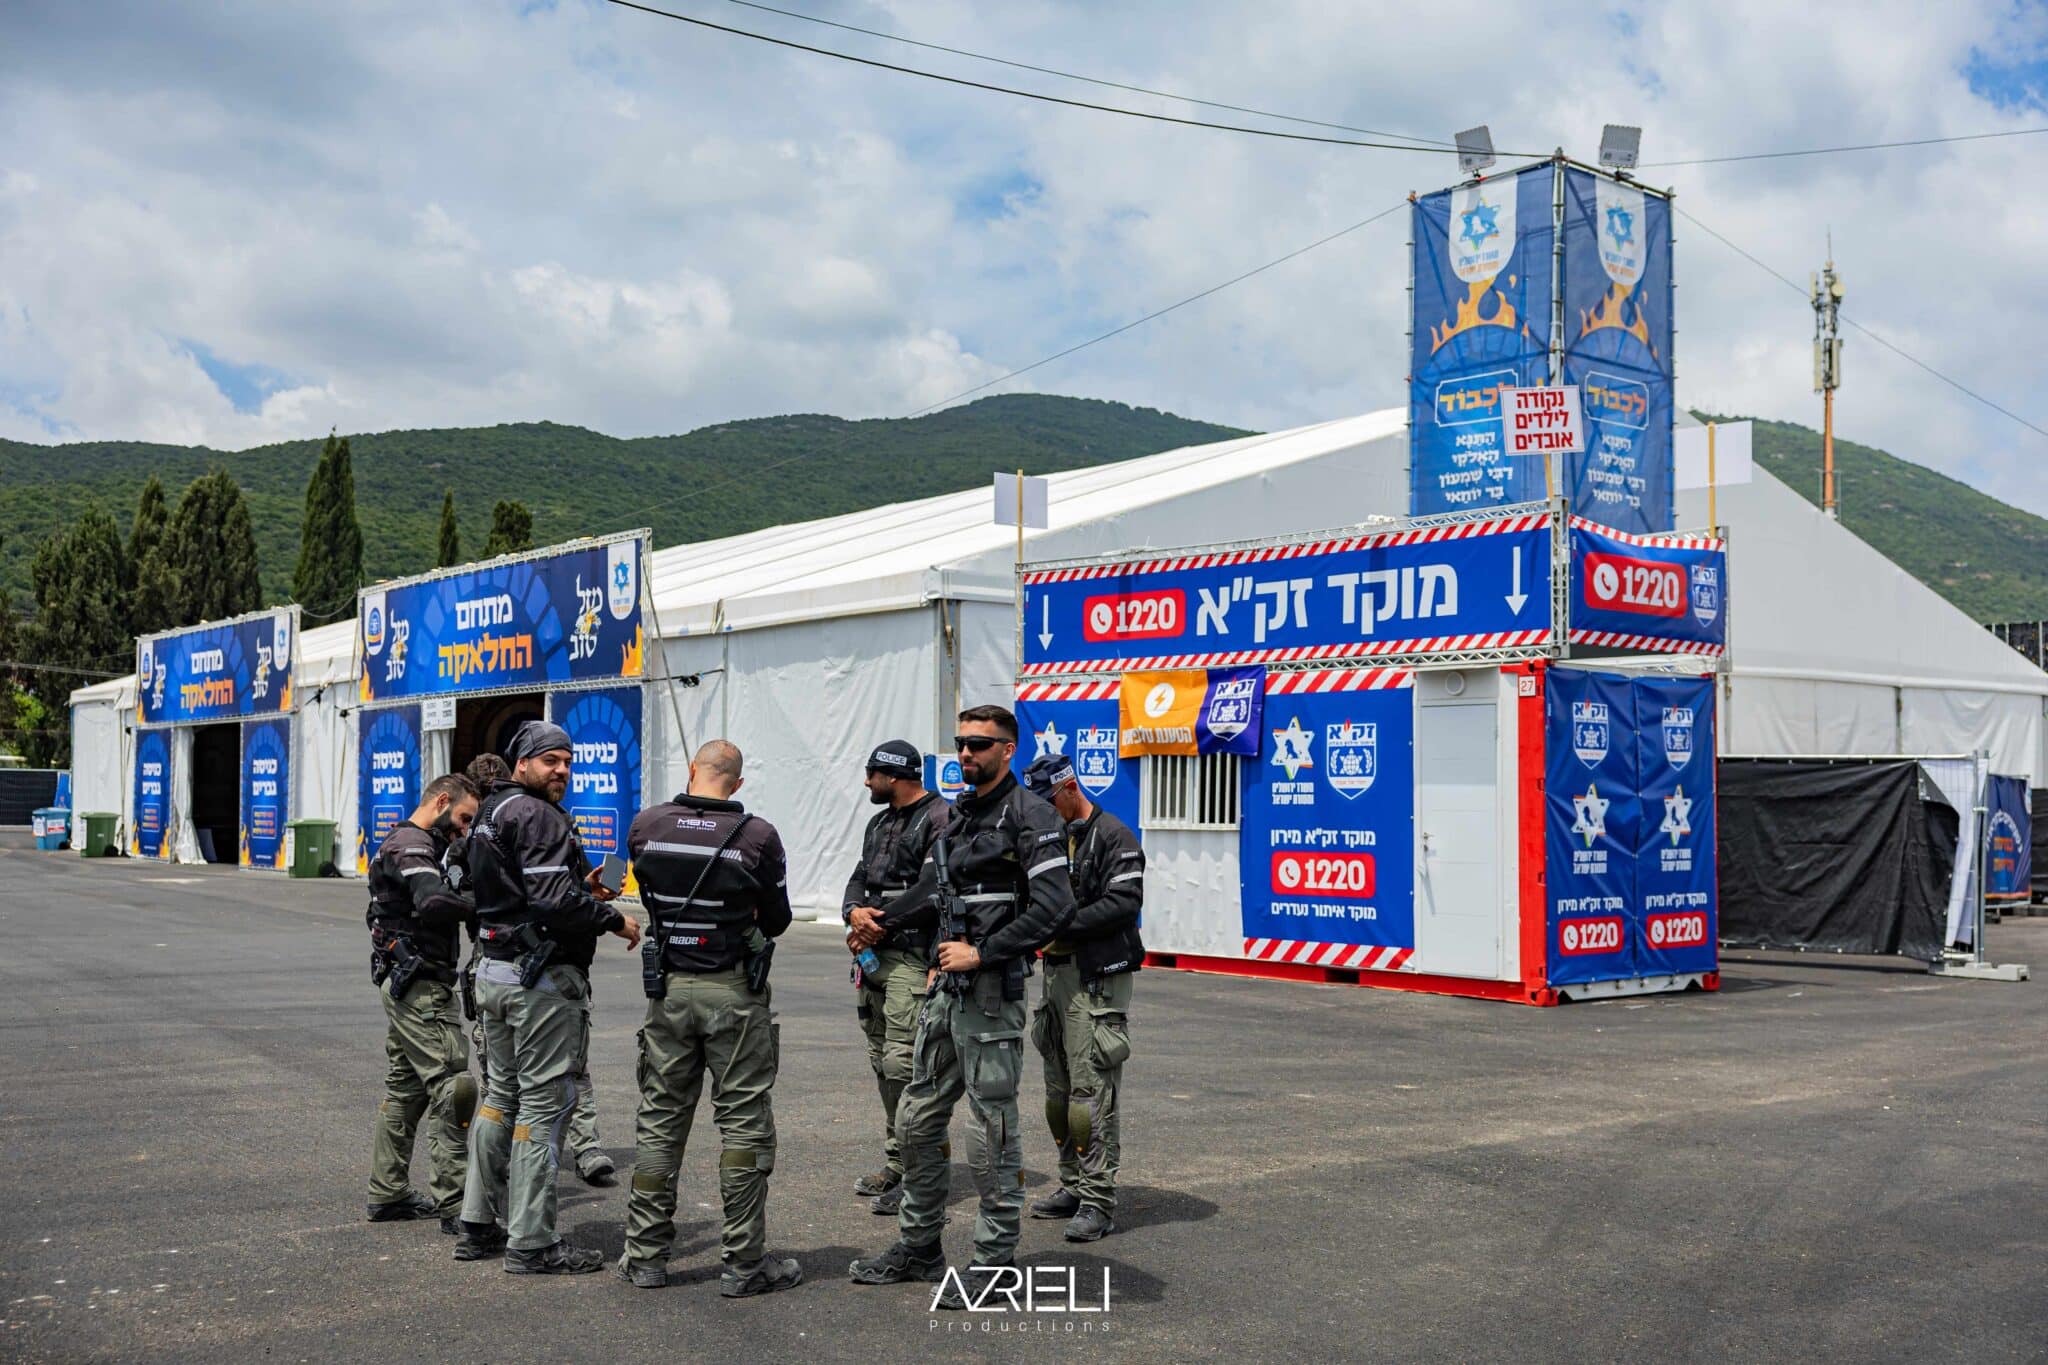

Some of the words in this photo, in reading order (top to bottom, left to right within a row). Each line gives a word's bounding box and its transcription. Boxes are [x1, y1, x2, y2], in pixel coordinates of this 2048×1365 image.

[1516, 391, 1564, 411] נקודה
[1515, 409, 1569, 429] לילדים
[1515, 432, 1573, 450] אובדים
[1621, 565, 1680, 609] 1220
[1327, 564, 1458, 635] מוקד
[455, 593, 513, 630] מתחם
[1116, 597, 1176, 633] 1220
[1196, 576, 1313, 644] זק"א
[191, 649, 224, 675] מתחם
[438, 632, 533, 684] החלאקה
[180, 676, 234, 714] החלאקה
[1520, 680, 1534, 693] 27
[372, 751, 405, 770] כניסה
[572, 742, 617, 764] כניסה
[876, 752, 906, 765] POLICE
[372, 776, 405, 795] גברים
[572, 772, 618, 794] גברים
[1270, 829, 1302, 847] מירון
[1305, 828, 1339, 848] זק"א
[1341, 830, 1376, 848] מוקד
[1304, 859, 1366, 891] 1220
[1271, 902, 1309, 915] נעדרים
[1557, 899, 1578, 914] מירון
[1603, 897, 1624, 912] מוקד
[1645, 895, 1665, 910] מירון
[1687, 892, 1708, 907] מוקד
[1311, 904, 1345, 918] איתור
[1347, 905, 1377, 922] מוקד
[1579, 922, 1619, 949] 1220
[1666, 916, 1703, 943] 1220
